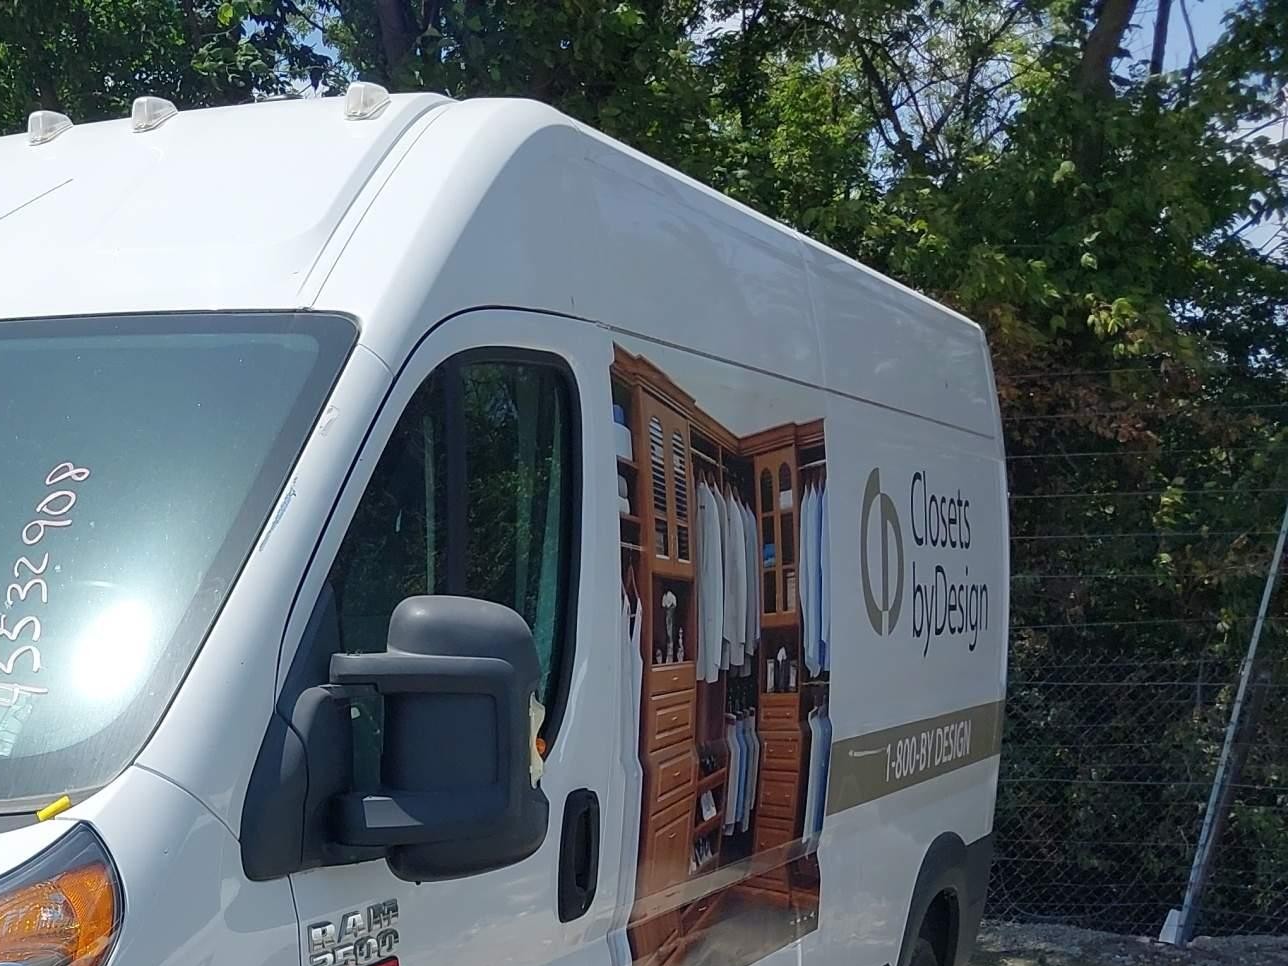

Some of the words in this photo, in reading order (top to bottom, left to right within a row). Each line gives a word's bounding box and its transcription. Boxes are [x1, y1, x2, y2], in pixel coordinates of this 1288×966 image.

[910, 469, 971, 550] Closets
[911, 560, 989, 659] byDesign
[885, 731, 935, 782] 1-800-BY
[935, 718, 972, 767] DESIGN
[306, 898, 399, 953] RAM
